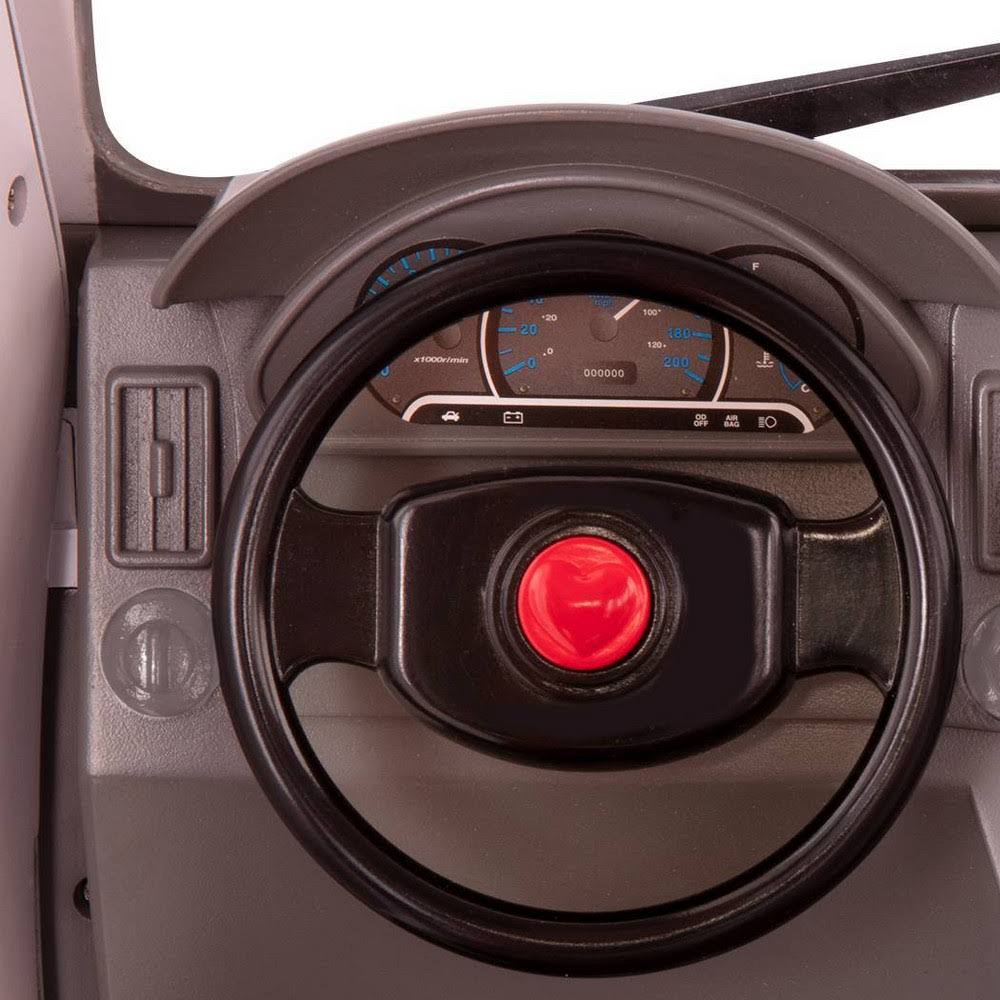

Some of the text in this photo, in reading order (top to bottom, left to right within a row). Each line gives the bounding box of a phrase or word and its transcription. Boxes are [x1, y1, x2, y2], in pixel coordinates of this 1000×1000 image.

[752, 262, 760, 271] F
[643, 308, 658, 317] 100
[545, 313, 558, 322] 20
[520, 323, 538, 336] 20
[668, 327, 690, 339] 180
[647, 341, 662, 349] 120
[547, 347, 554, 355] 0
[413, 356, 469, 364] x1000r/min
[527, 357, 536, 369] 0
[663, 356, 689, 368] 200
[583, 368, 625, 378] 000000
[800, 383, 811, 393] C
[695, 413, 707, 421] OD
[693, 420, 709, 428] OFF
[724, 420, 740, 428] BAG
